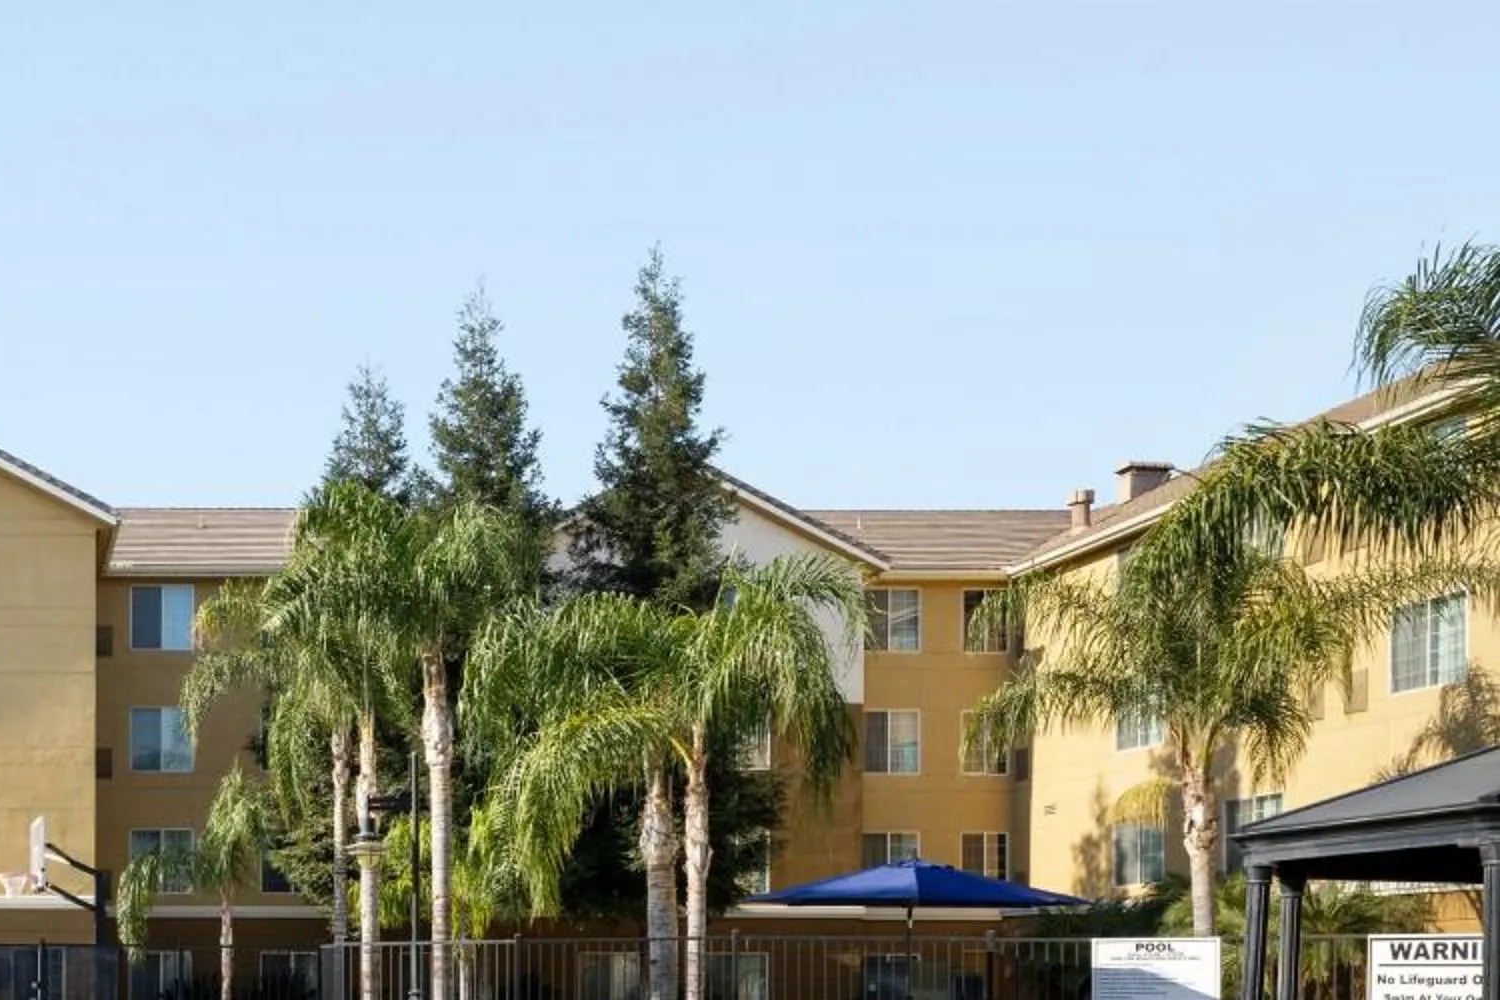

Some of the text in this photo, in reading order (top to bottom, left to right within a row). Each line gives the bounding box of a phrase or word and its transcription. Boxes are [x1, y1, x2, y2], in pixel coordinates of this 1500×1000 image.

[1135, 943, 1175, 953] POOL
[1389, 942, 1479, 961] WARNI
[1377, 974, 1483, 987] No Lifeguard O
